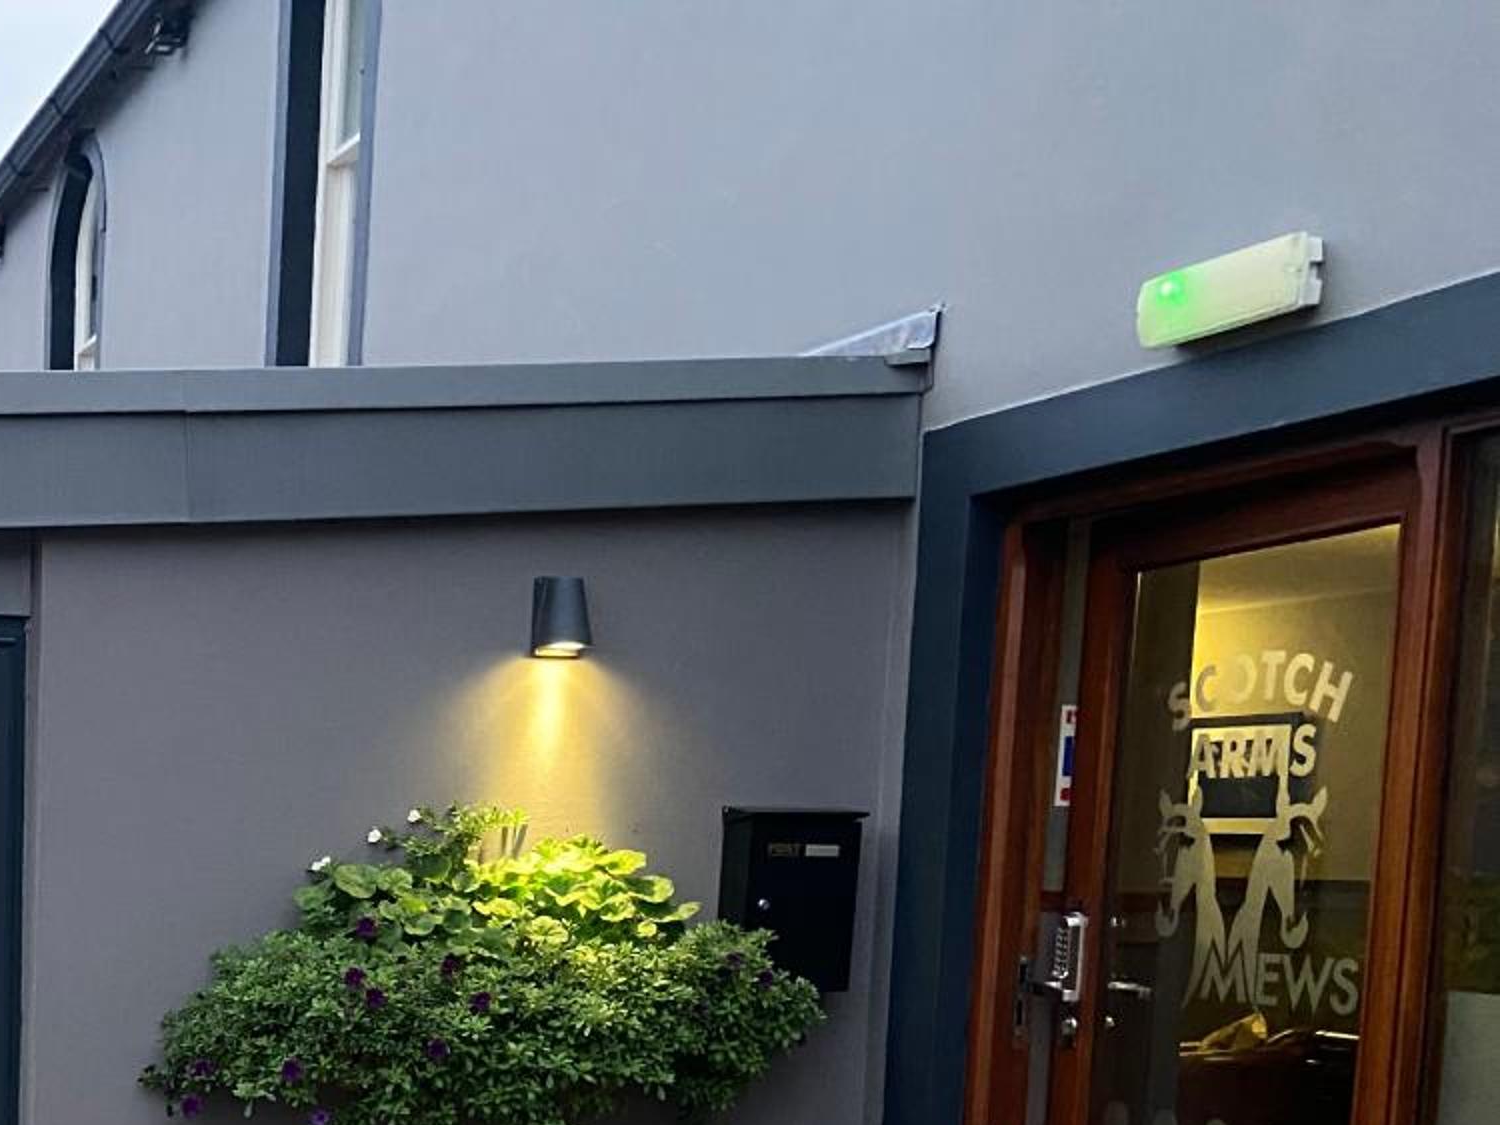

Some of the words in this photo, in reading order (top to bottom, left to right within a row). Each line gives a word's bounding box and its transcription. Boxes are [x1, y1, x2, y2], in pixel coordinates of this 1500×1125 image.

[1167, 650, 1353, 731] SCOTCH
[1187, 724, 1317, 778] ARMS
[1200, 940, 1359, 1016] MEWS
